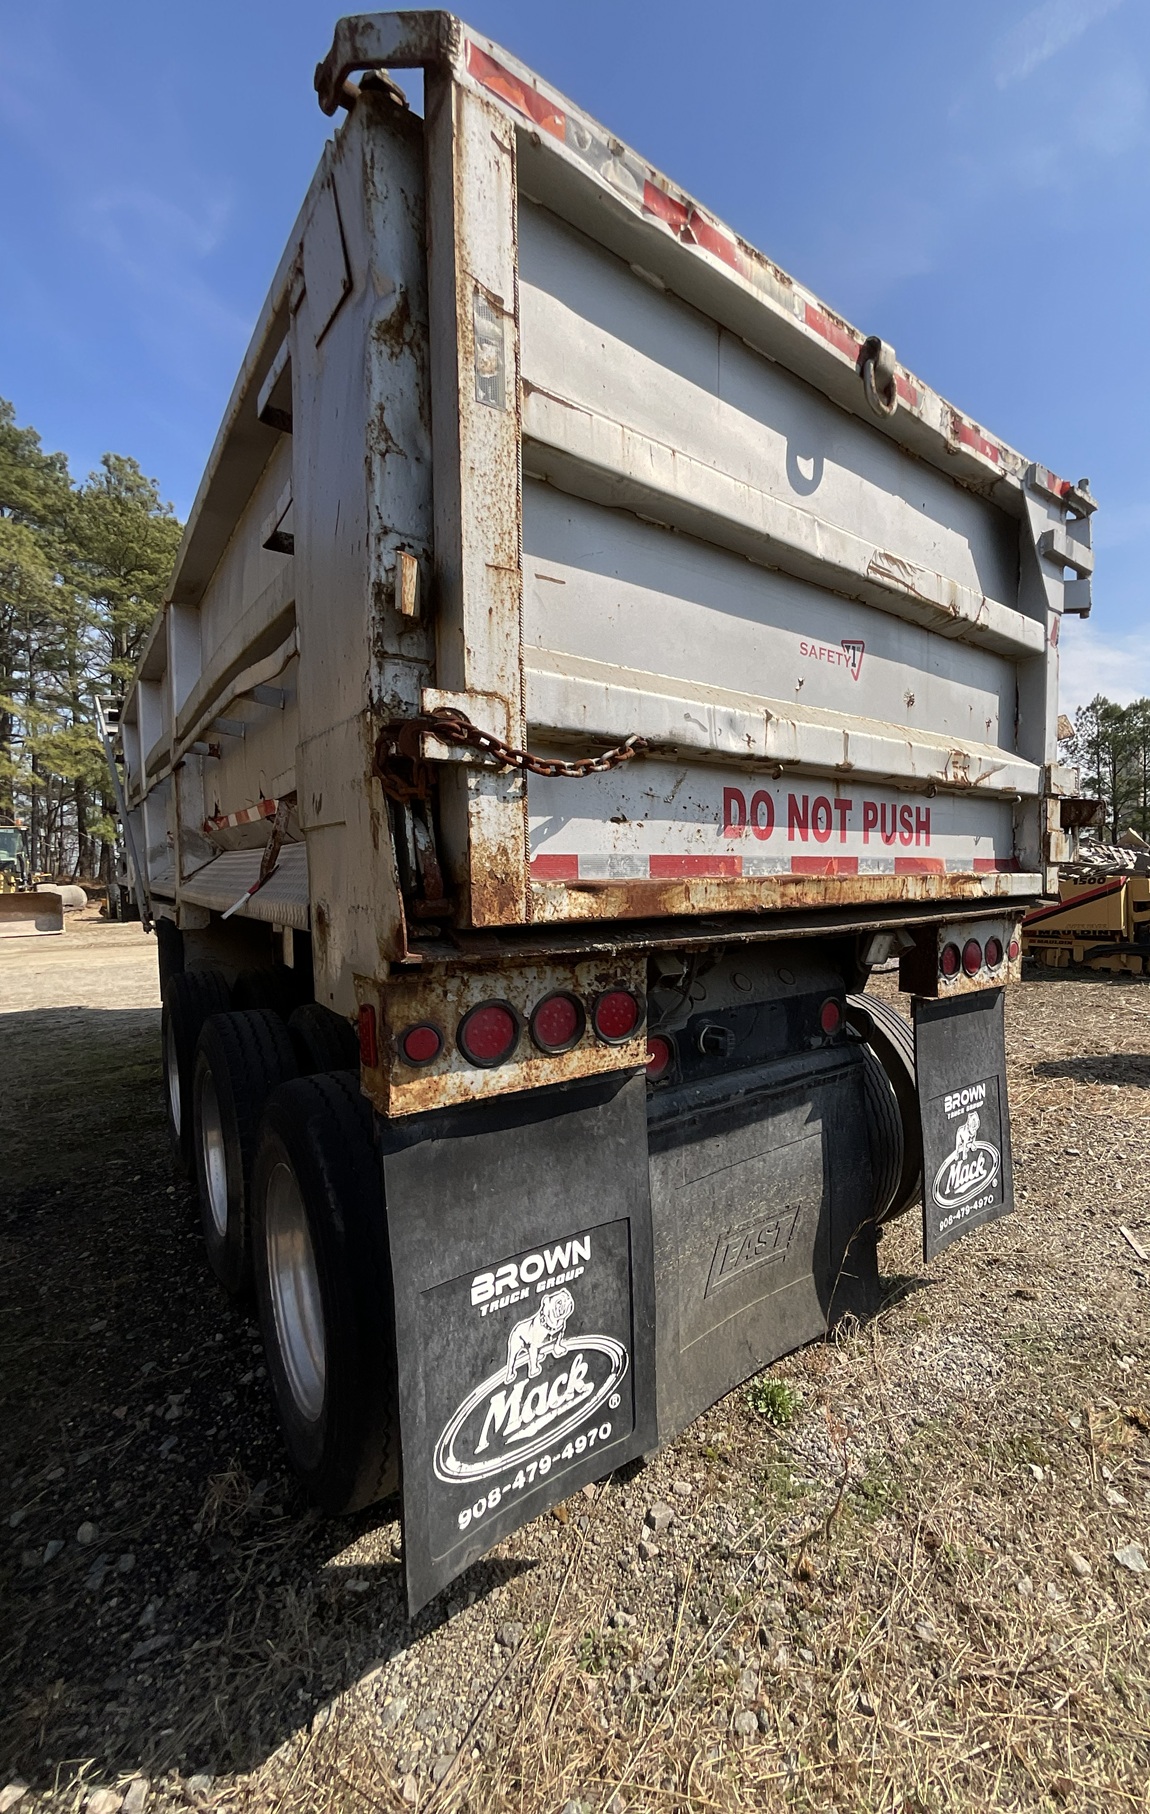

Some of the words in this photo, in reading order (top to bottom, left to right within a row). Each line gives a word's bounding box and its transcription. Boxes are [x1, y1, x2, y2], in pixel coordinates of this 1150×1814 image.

[800, 642, 851, 668] SAFETY
[723, 787, 775, 841] DO
[788, 793, 852, 843] NOT
[863, 801, 931, 846] PUSH
[1072, 877, 1106, 885] 1500
[944, 1083, 986, 1113] BROWN
[944, 1151, 987, 1195] Mack
[939, 1194, 994, 1232] 908-479-4970
[470, 1235, 592, 1307] BROWN
[479, 1290, 530, 1317] TRUCK
[535, 1266, 585, 1294] GROUP
[473, 1353, 595, 1455] Mack
[457, 1422, 612, 1530] 908-479-4970
